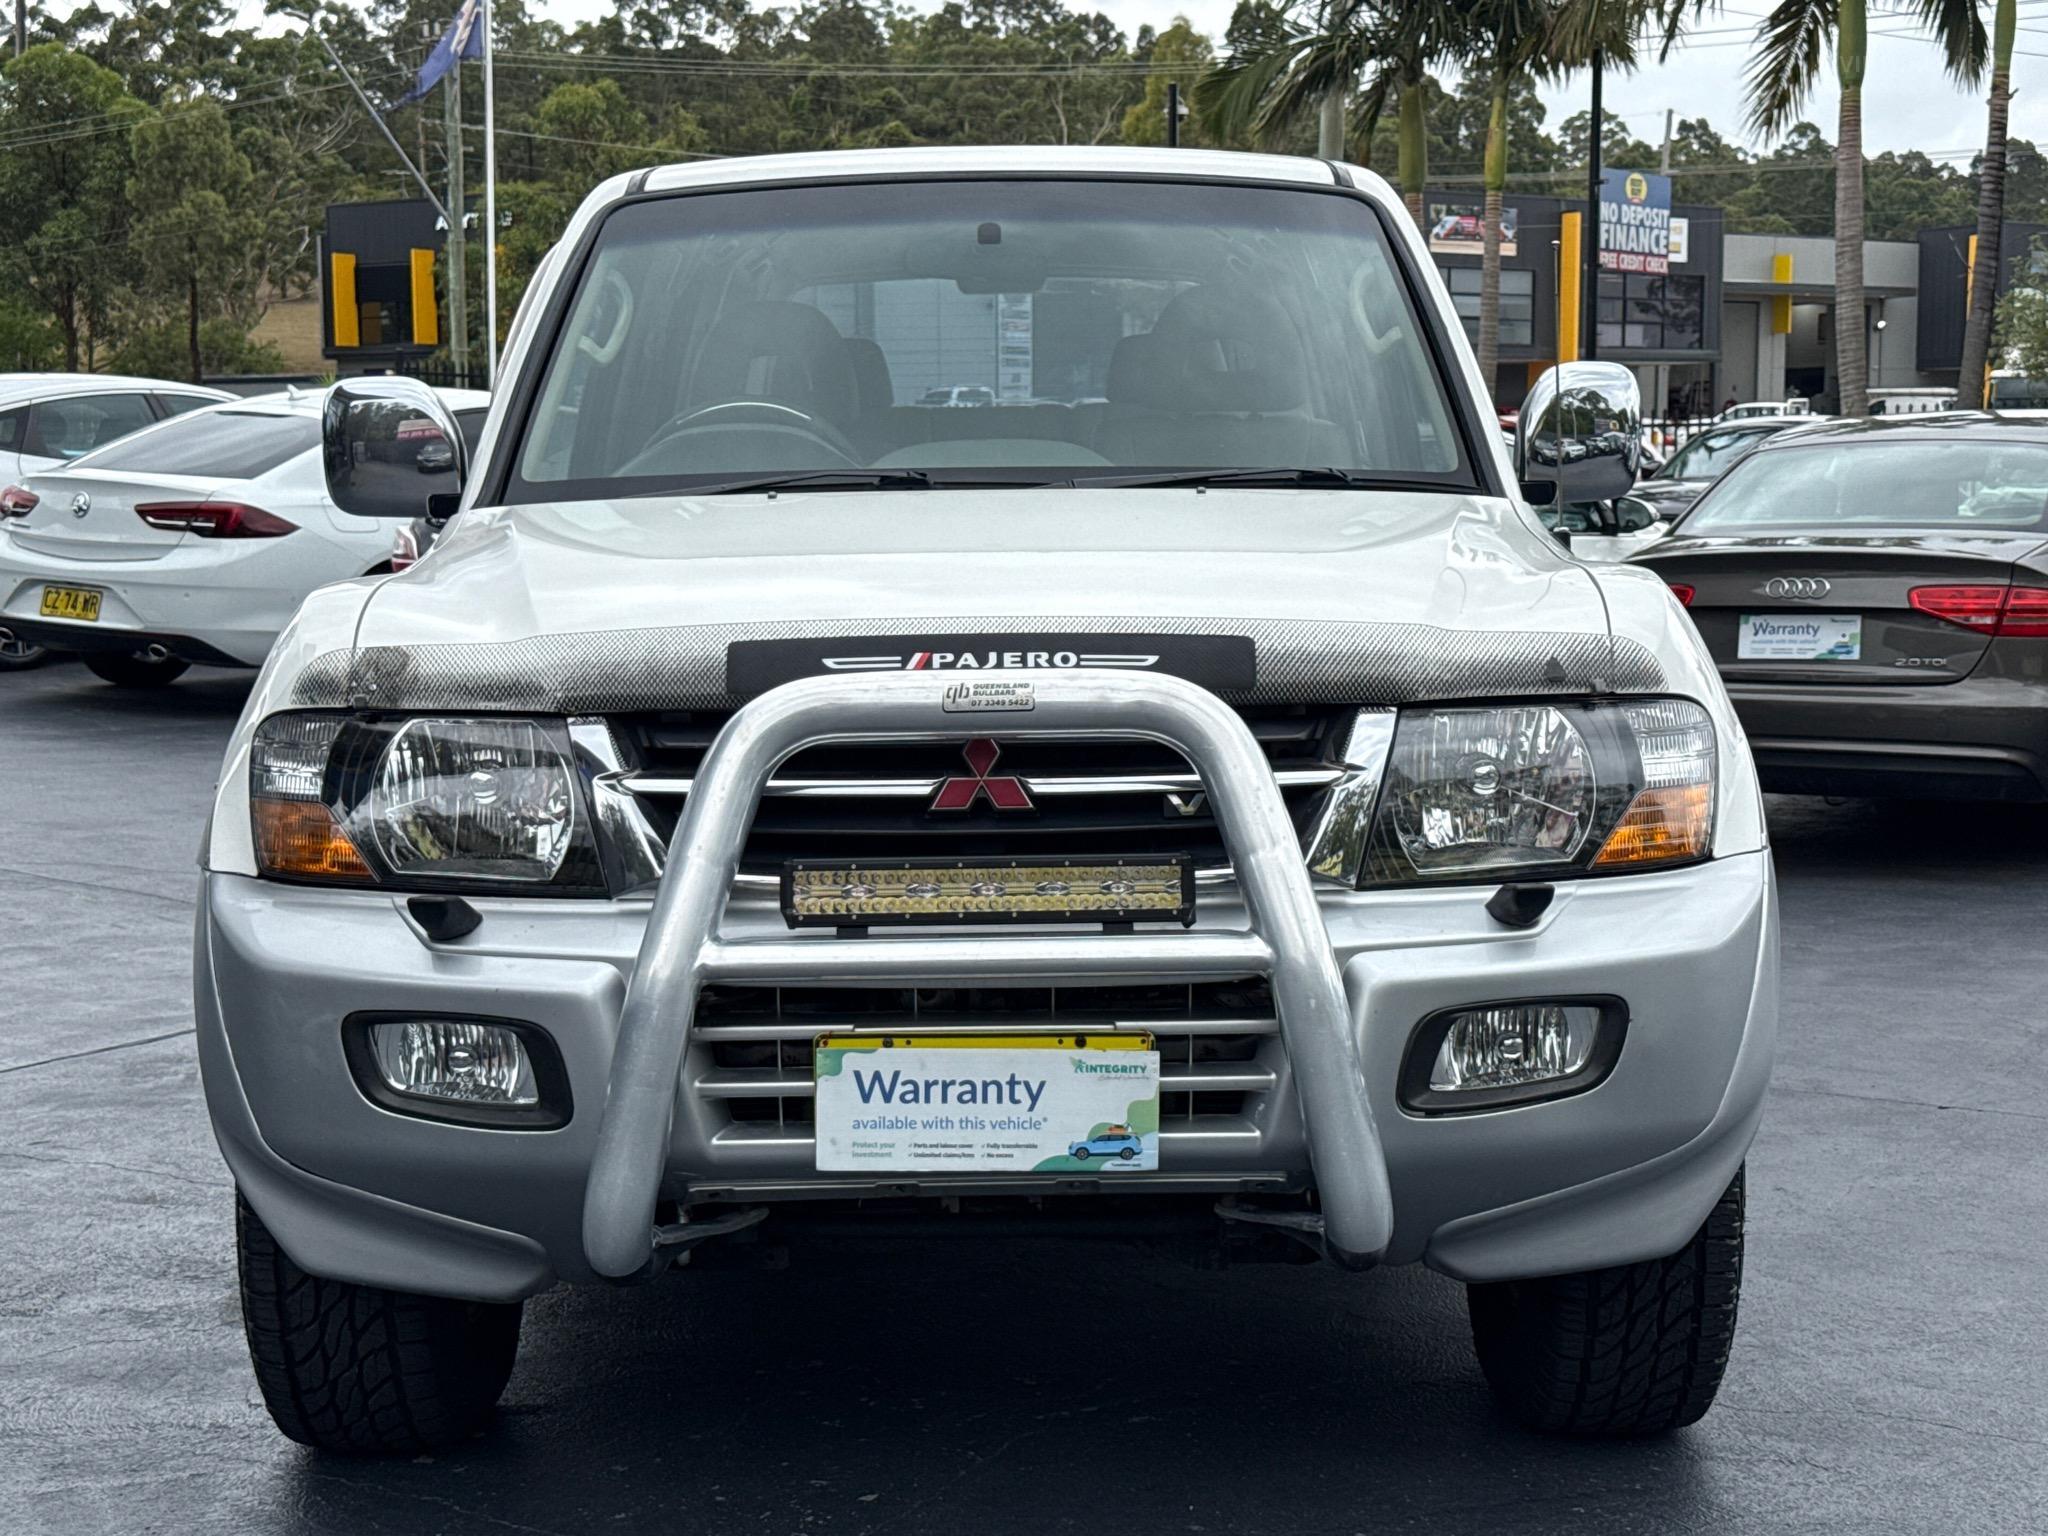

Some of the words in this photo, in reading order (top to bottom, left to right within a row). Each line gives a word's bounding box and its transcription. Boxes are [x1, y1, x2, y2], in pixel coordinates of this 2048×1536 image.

[1600, 201, 1619, 223] NO
[1621, 204, 1670, 229] DEPOSIT
[1600, 222, 1668, 255] FINANCE
[1753, 621, 1821, 637] Warranty
[932, 651, 1078, 669] PAJERO
[1922, 657, 1947, 666] TDI
[972, 689, 1017, 697] BULLBARS
[1085, 1064, 1148, 1074] INTEGRITY
[853, 1070, 1047, 1112] Warranty
[852, 1116, 918, 1130] available
[922, 1116, 954, 1130] with
[959, 1116, 985, 1130] this
[852, 1141, 878, 1149] Protect
